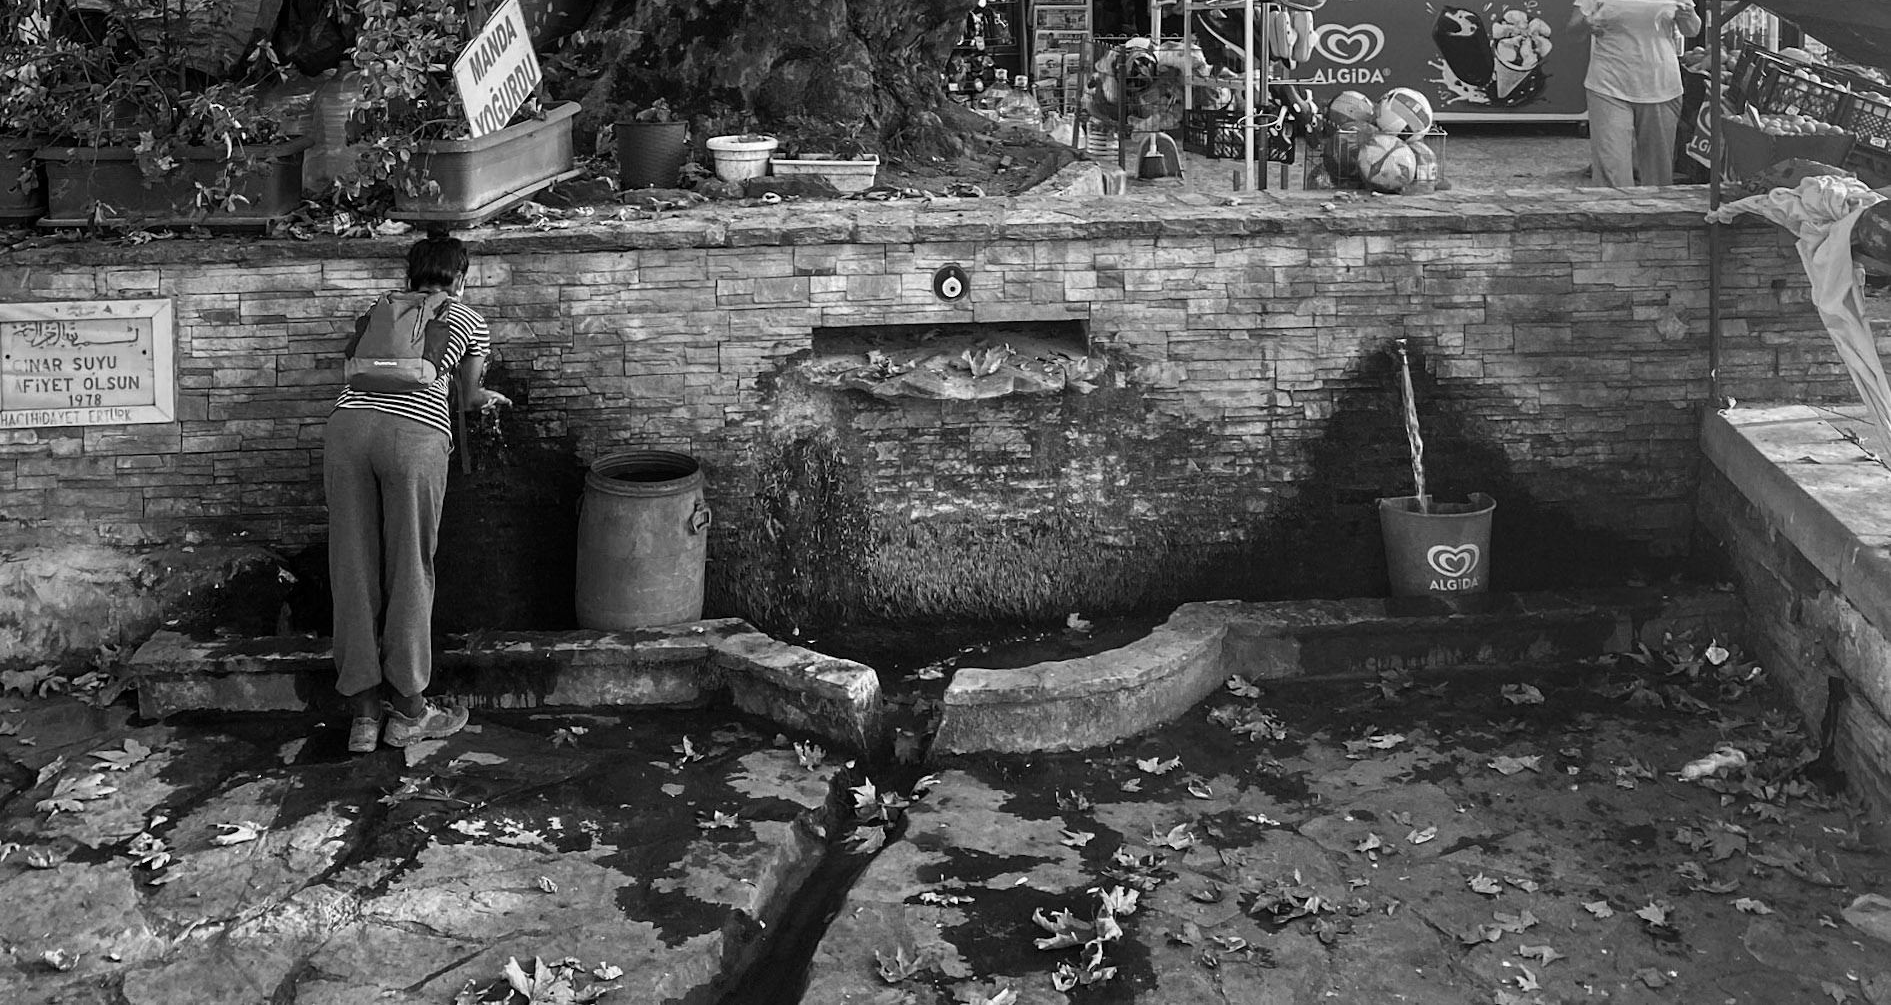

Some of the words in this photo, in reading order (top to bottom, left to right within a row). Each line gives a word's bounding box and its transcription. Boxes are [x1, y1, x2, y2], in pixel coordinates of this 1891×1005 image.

[469, 15, 518, 86] MANDA
[73, 355, 118, 371] SUYU
[83, 375, 140, 391] OLSUN
[68, 393, 102, 407] 1978
